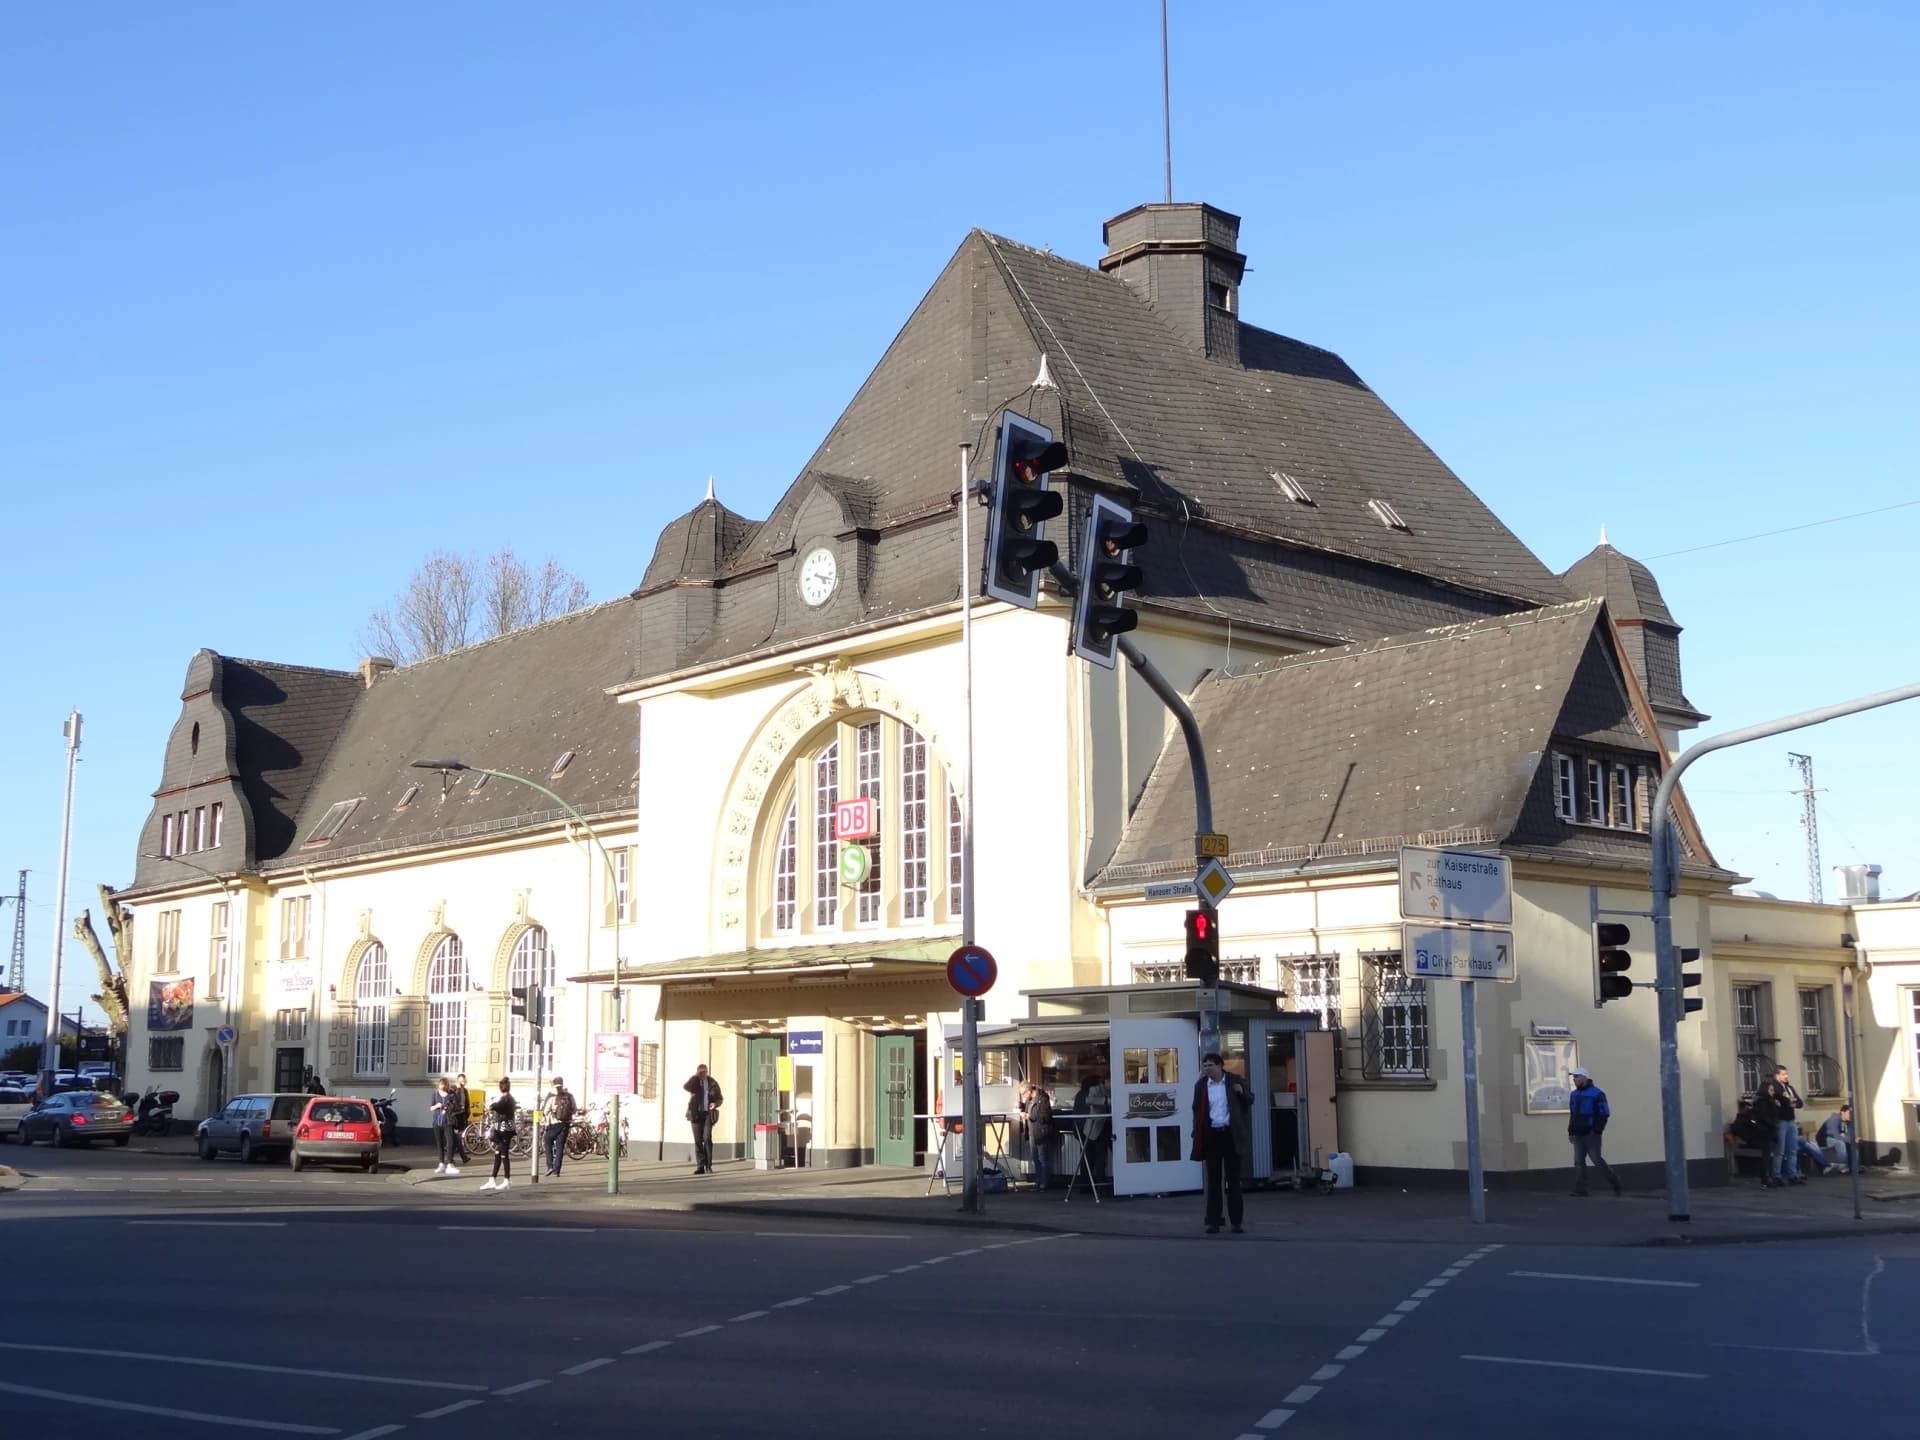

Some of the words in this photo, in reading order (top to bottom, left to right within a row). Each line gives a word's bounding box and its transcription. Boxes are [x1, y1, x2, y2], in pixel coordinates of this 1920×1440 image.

[840, 805, 865, 832] DB
[1203, 839, 1225, 853] 275
[843, 848, 861, 880] S
[1426, 859, 1440, 869] zur
[1444, 858, 1499, 876] Kaiserstraße
[1148, 887, 1172, 897] Hanauer
[1173, 885, 1193, 895] Straße
[1427, 875, 1463, 890] Rathaus
[1431, 954, 1493, 971] City-Parkhaus
